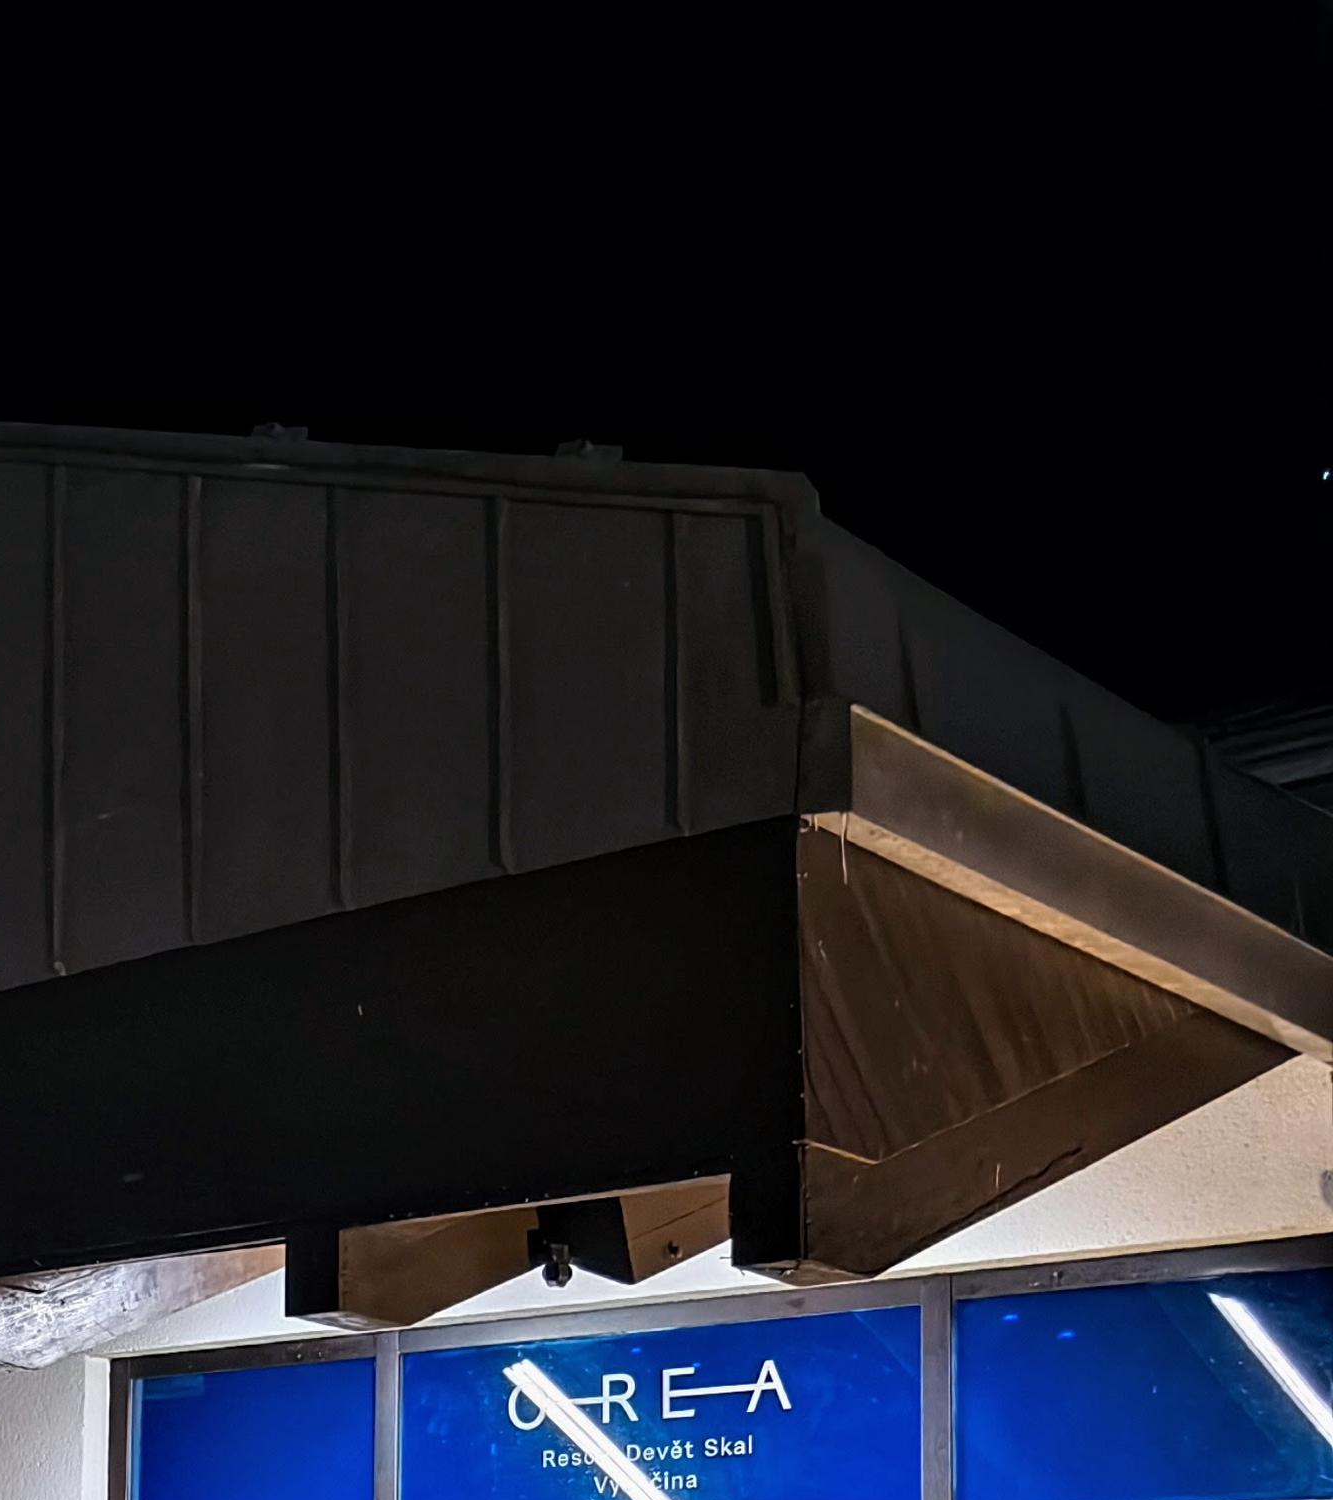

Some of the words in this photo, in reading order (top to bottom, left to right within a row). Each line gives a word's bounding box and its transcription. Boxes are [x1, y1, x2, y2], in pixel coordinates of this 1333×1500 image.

[508, 1359, 792, 1431] OREA
[542, 1449, 599, 1468] Reso
[626, 1440, 694, 1462] Devět
[704, 1435, 753, 1457] Skal
[593, 1471, 698, 1498] Vyčina
